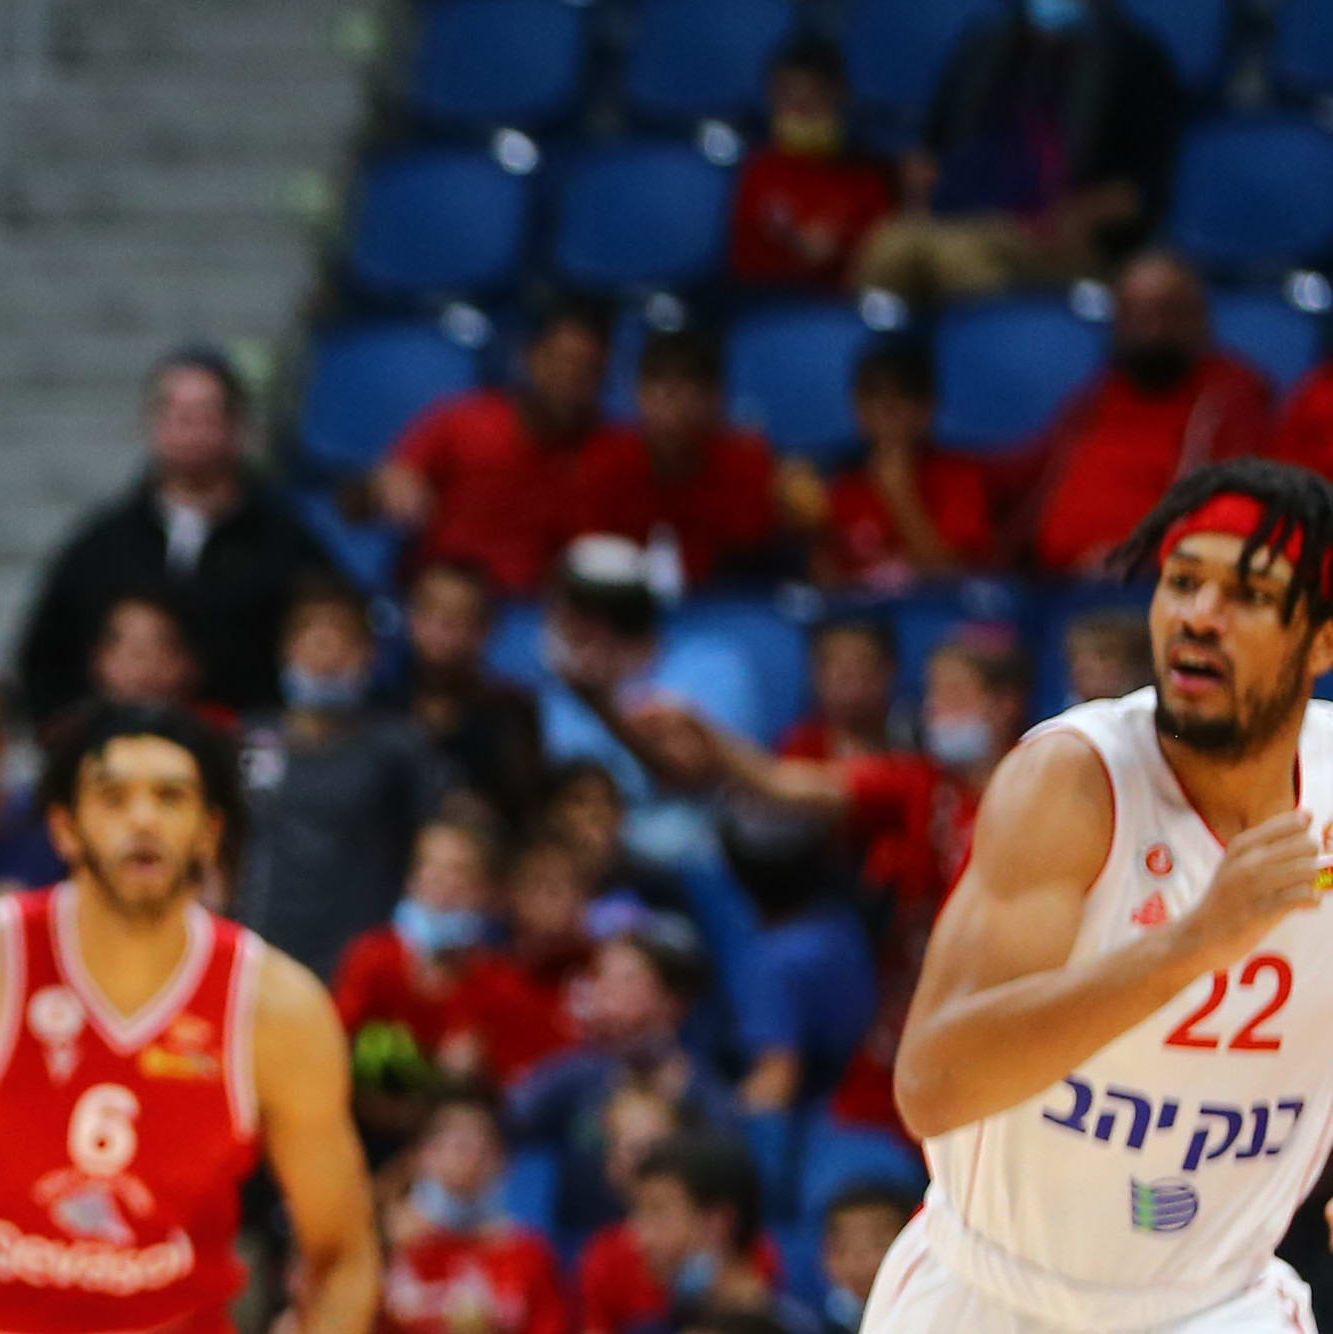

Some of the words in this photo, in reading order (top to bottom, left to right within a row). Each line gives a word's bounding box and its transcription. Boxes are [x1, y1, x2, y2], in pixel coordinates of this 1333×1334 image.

[1163, 951, 1295, 1051] 22
[66, 1083, 141, 1178] 6
[1042, 1075, 1179, 1150] יהב
